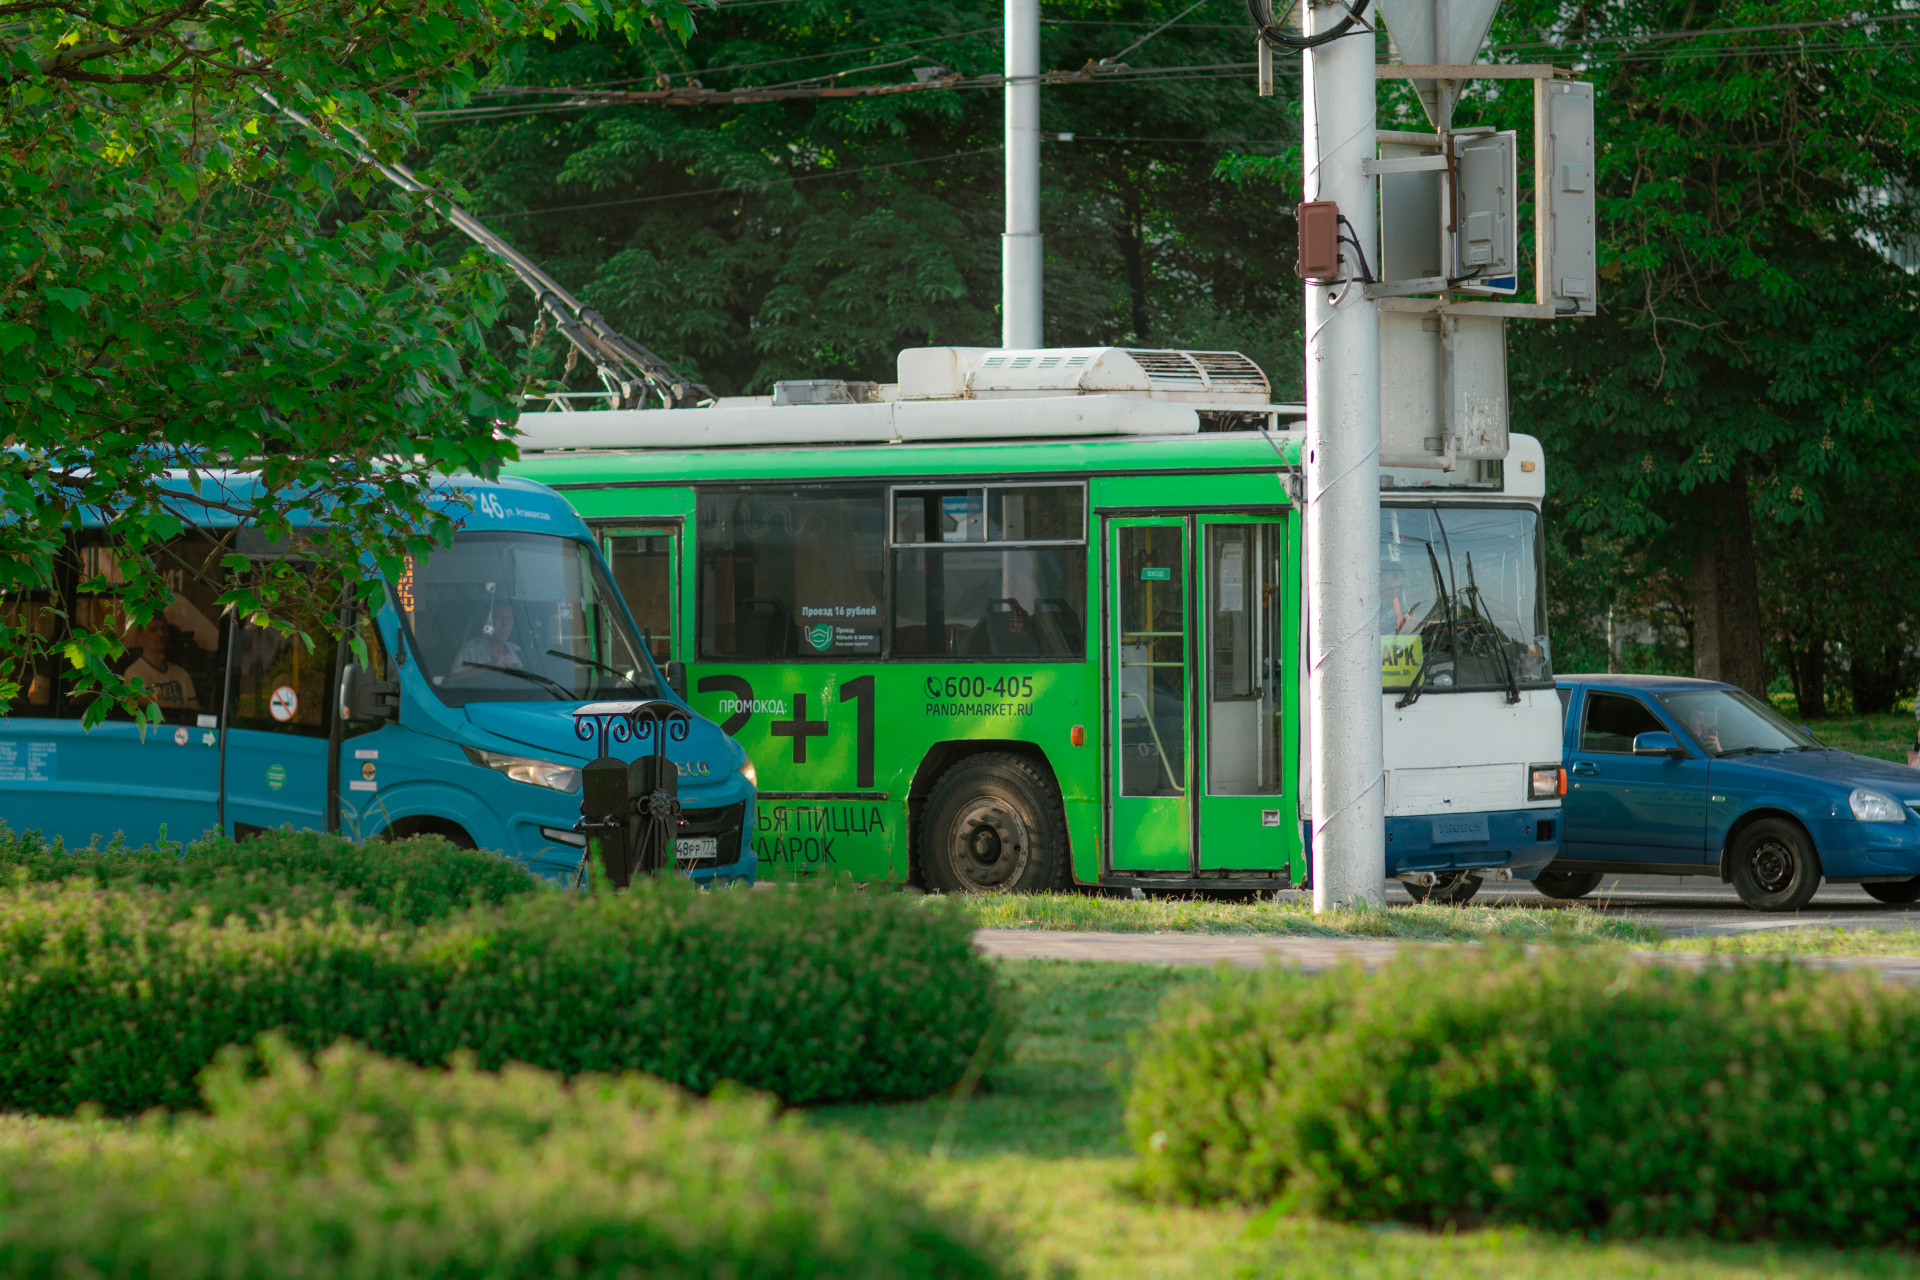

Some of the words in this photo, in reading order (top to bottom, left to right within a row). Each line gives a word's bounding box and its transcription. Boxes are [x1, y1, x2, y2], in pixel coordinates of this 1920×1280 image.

[480, 492, 504, 519] 46
[1147, 570, 1164, 578] ВХОД
[802, 606, 833, 618] Проезд
[835, 606, 845, 616] 16
[846, 605, 877, 618] рублей
[1382, 644, 1420, 666] АРК
[945, 676, 1033, 698] 600-405
[719, 699, 787, 715] ПРОМОКОД:
[926, 703, 1034, 716] PANDAMARKET.RU
[677, 761, 710, 777] ECO
[757, 806, 788, 832] ЬЯ
[797, 806, 885, 836] ПИЦЦА
[758, 837, 837, 866] ДАРОК
